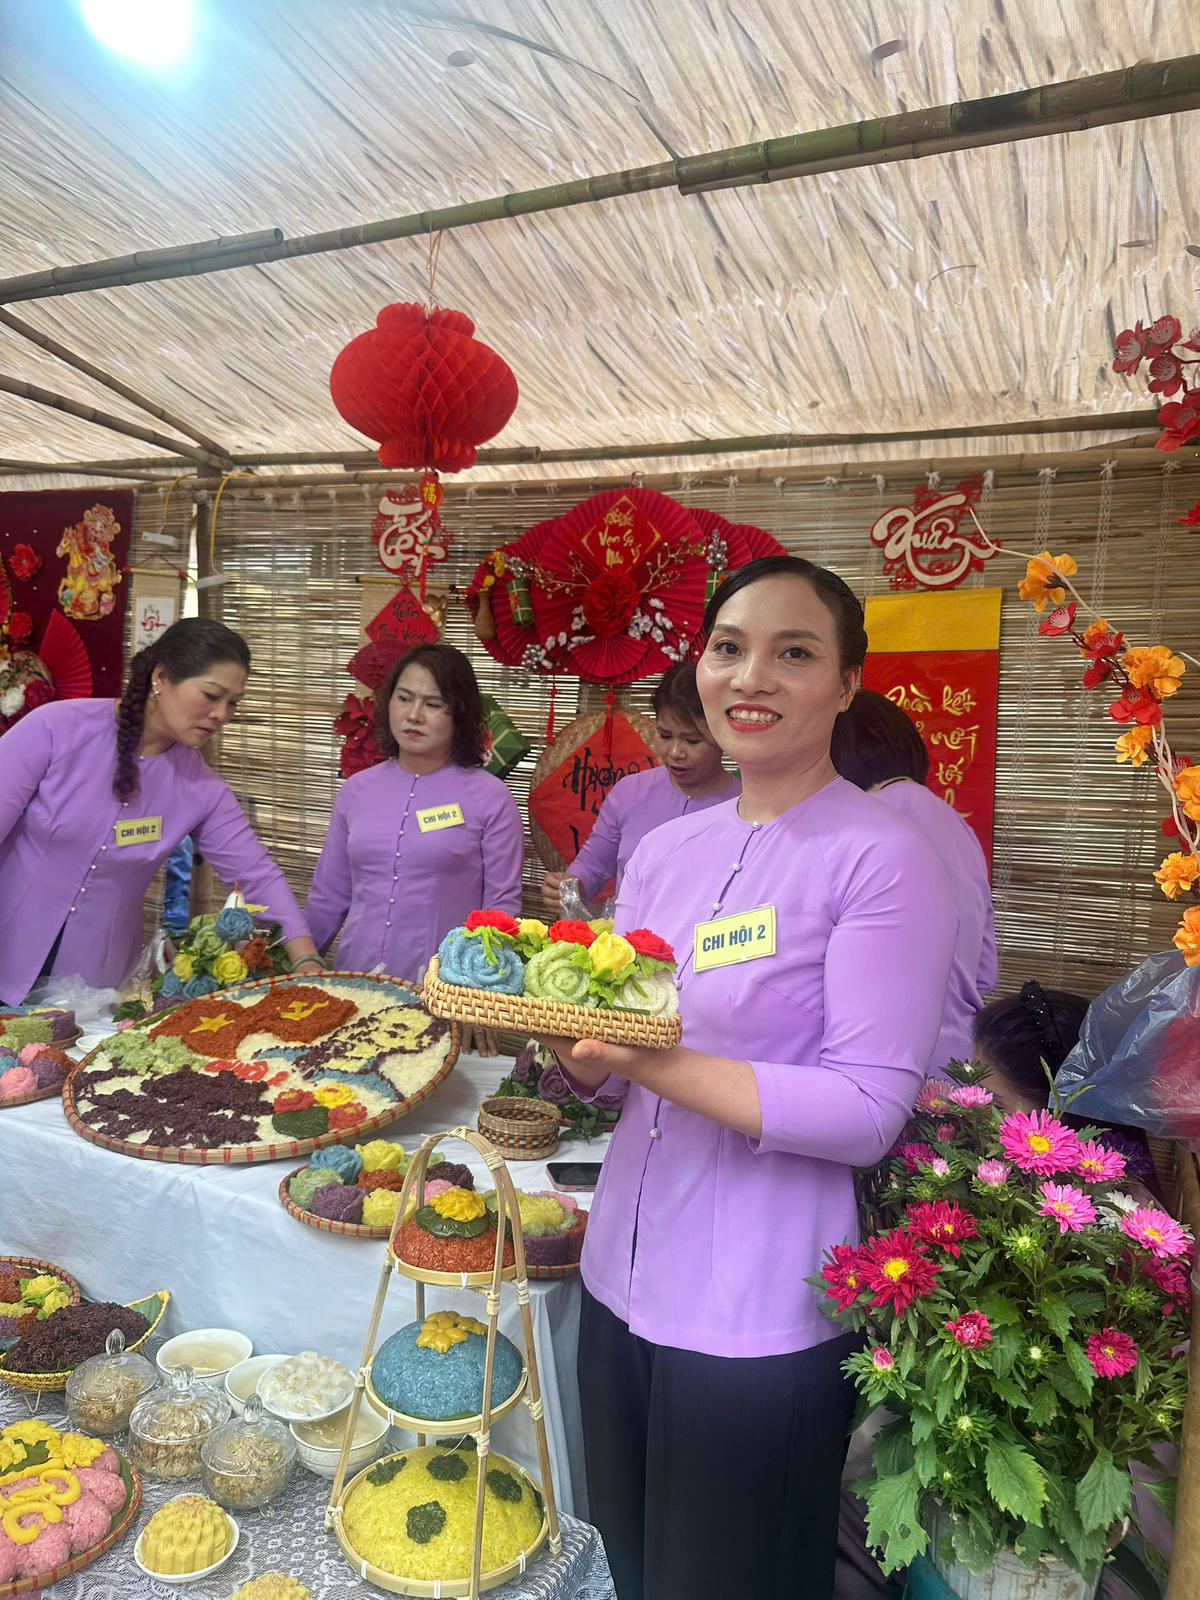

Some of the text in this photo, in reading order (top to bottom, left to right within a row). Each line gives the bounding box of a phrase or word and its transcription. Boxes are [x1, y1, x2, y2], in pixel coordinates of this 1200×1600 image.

[872, 493, 996, 586] Xuân
[423, 815, 436, 824] CHI
[121, 829, 134, 838] CHI
[151, 825, 157, 833] 2
[702, 924, 766, 952] CHI HỘI 2
